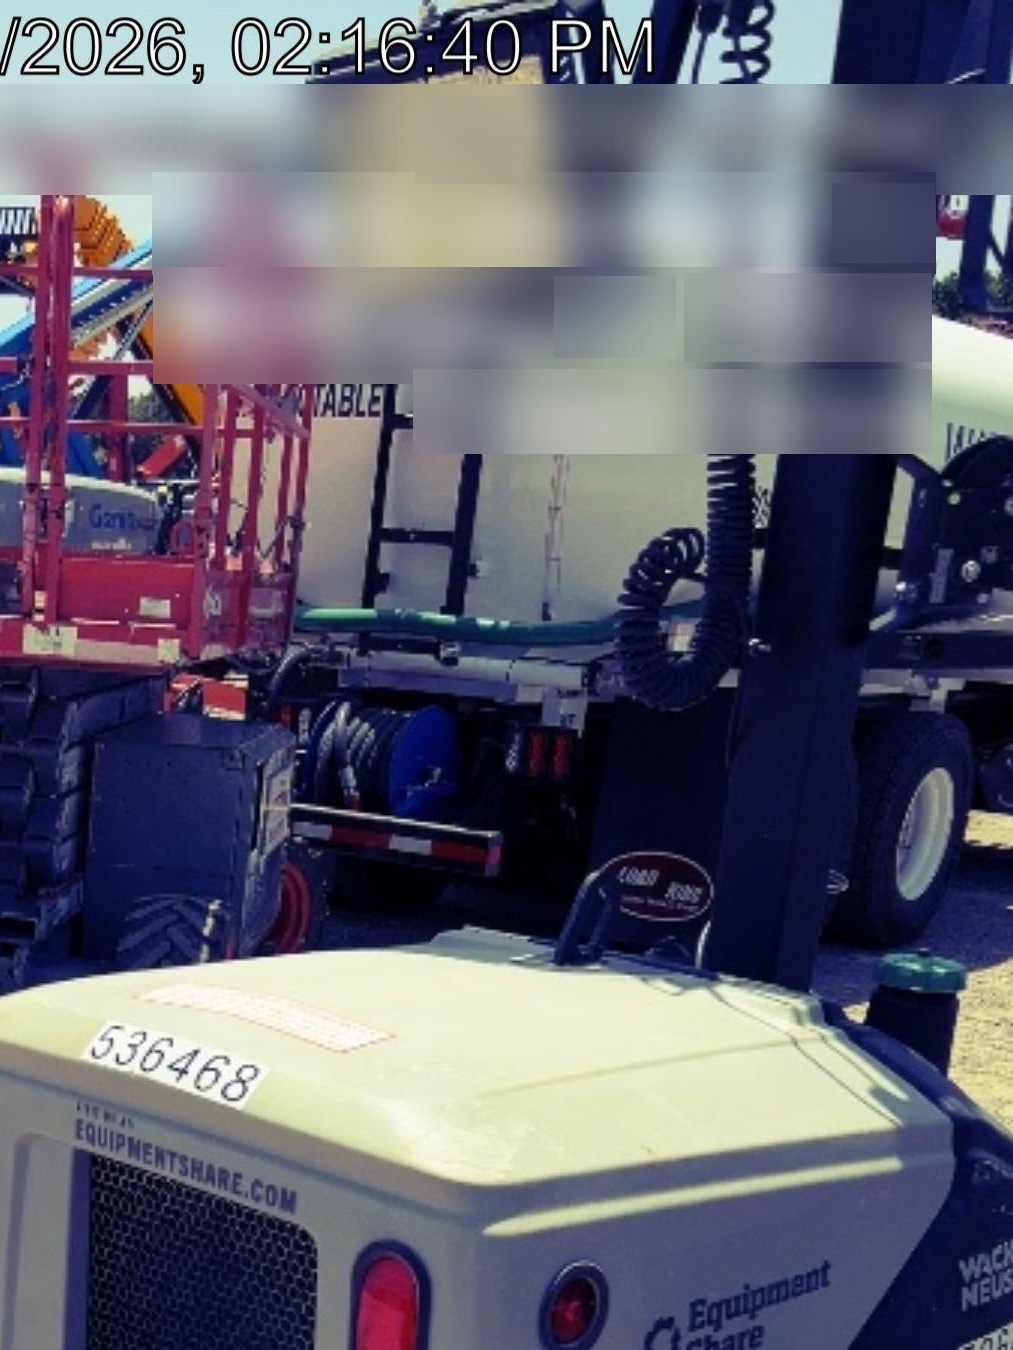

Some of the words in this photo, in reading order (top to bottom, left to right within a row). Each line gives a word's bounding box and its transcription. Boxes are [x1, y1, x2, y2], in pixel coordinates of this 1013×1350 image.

[90, 1025, 260, 1101] 536468
[75, 1118, 298, 1215] EQUIPMENTSHARE.COM
[689, 1260, 831, 1333] Equipment
